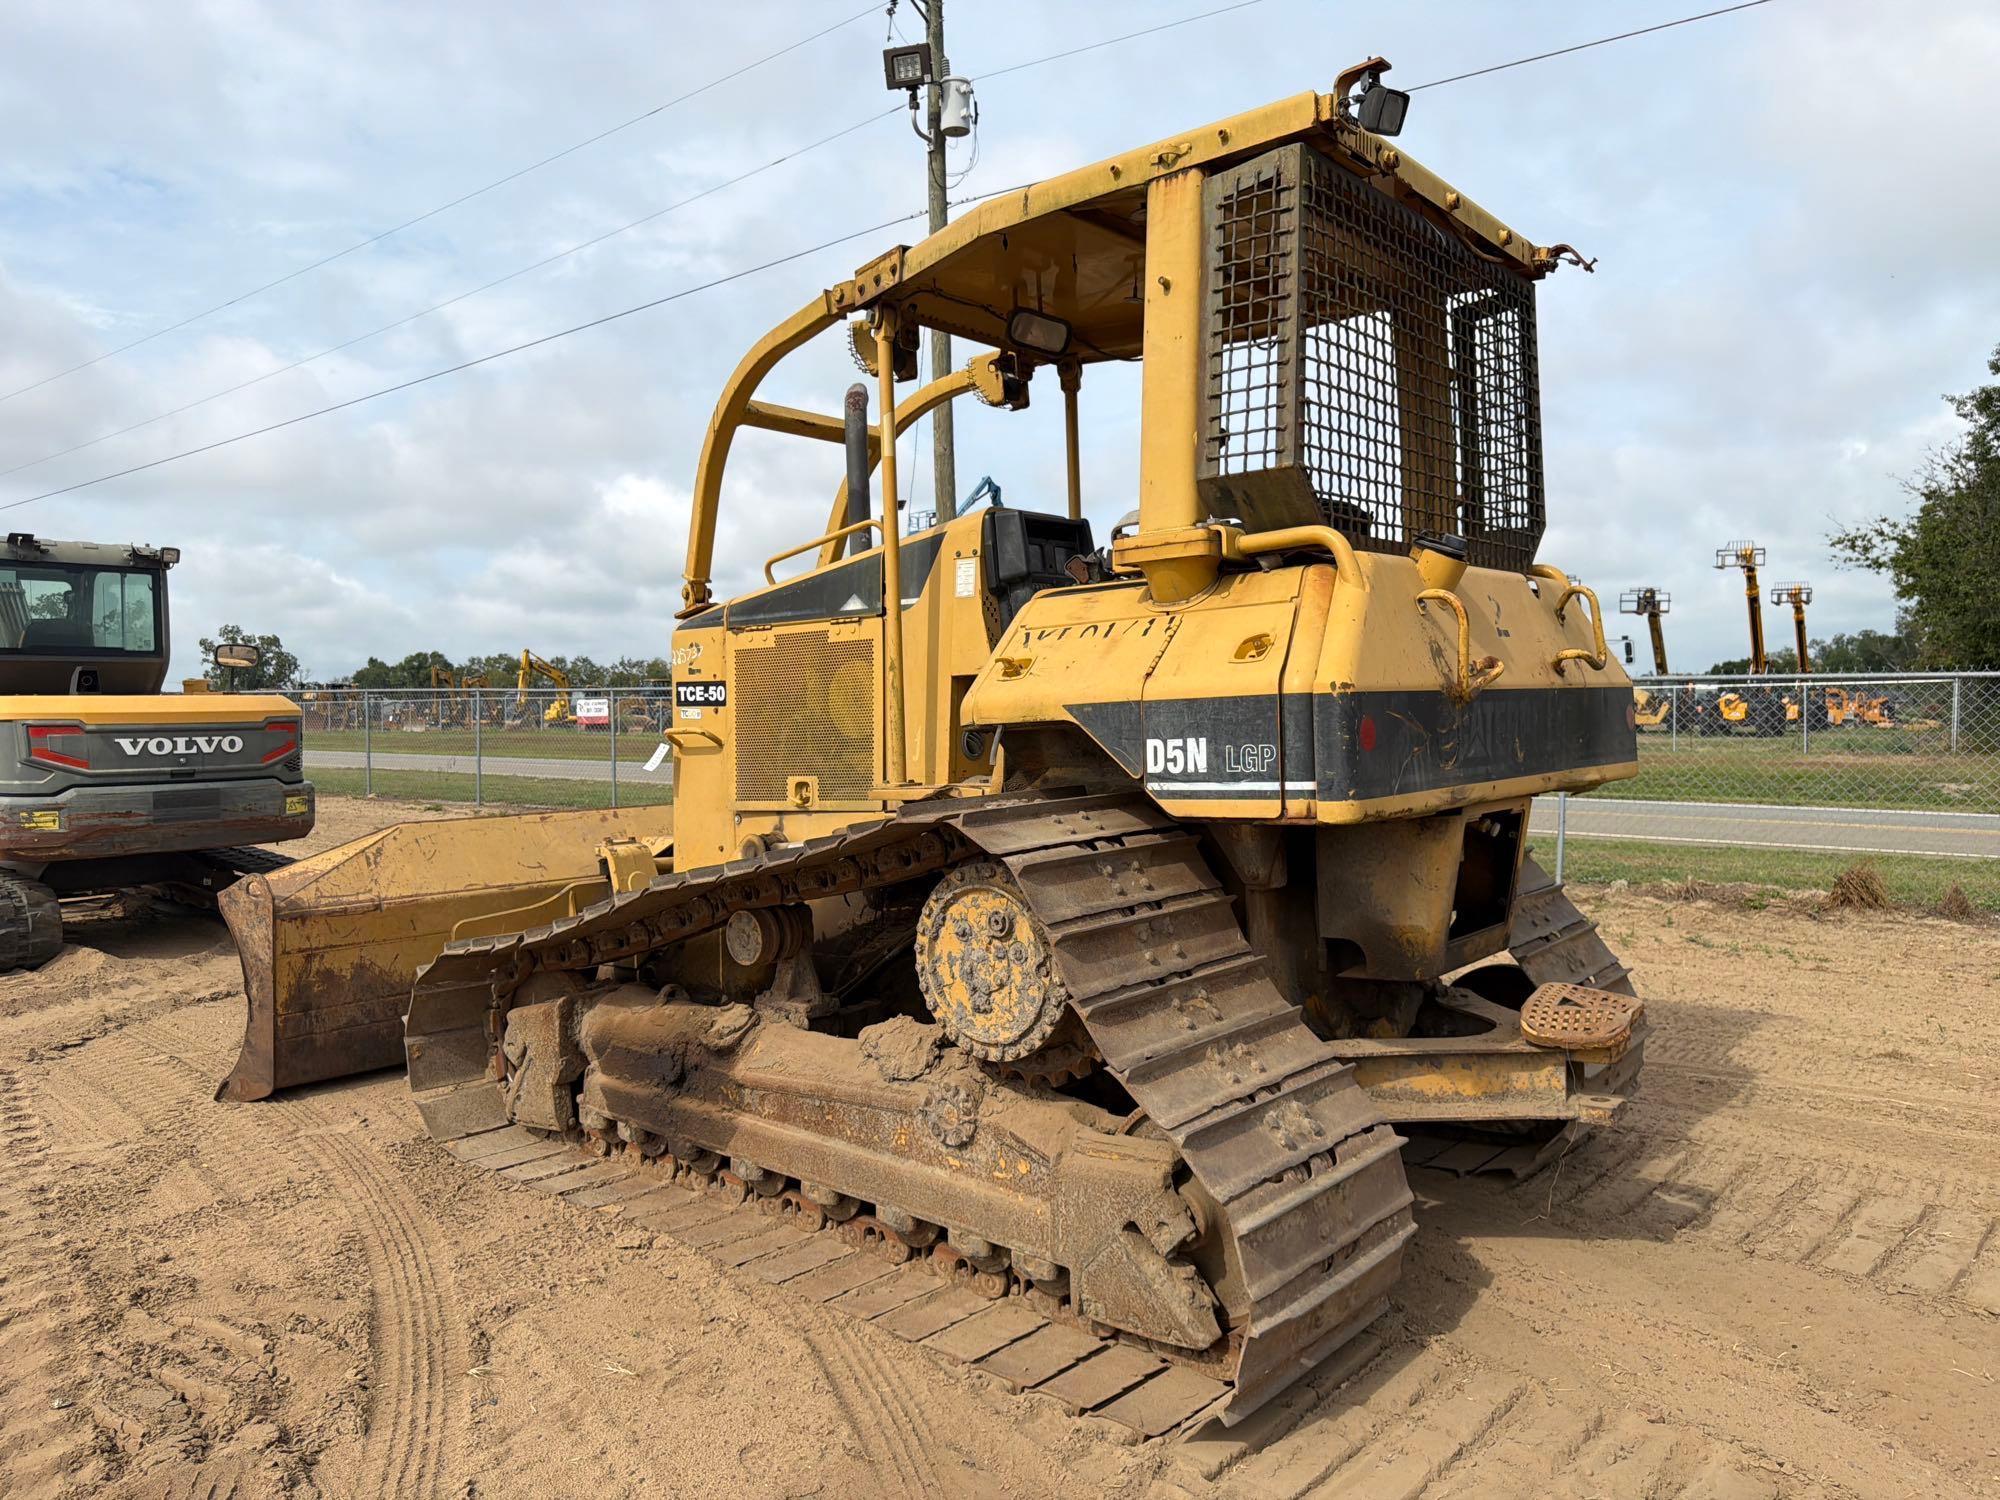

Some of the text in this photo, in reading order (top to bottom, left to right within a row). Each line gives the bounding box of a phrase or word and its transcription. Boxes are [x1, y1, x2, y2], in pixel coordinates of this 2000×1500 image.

[678, 686, 725, 702] TCE-50
[114, 735, 244, 756] VOLVO
[1146, 737, 1277, 774] D5N LGP
